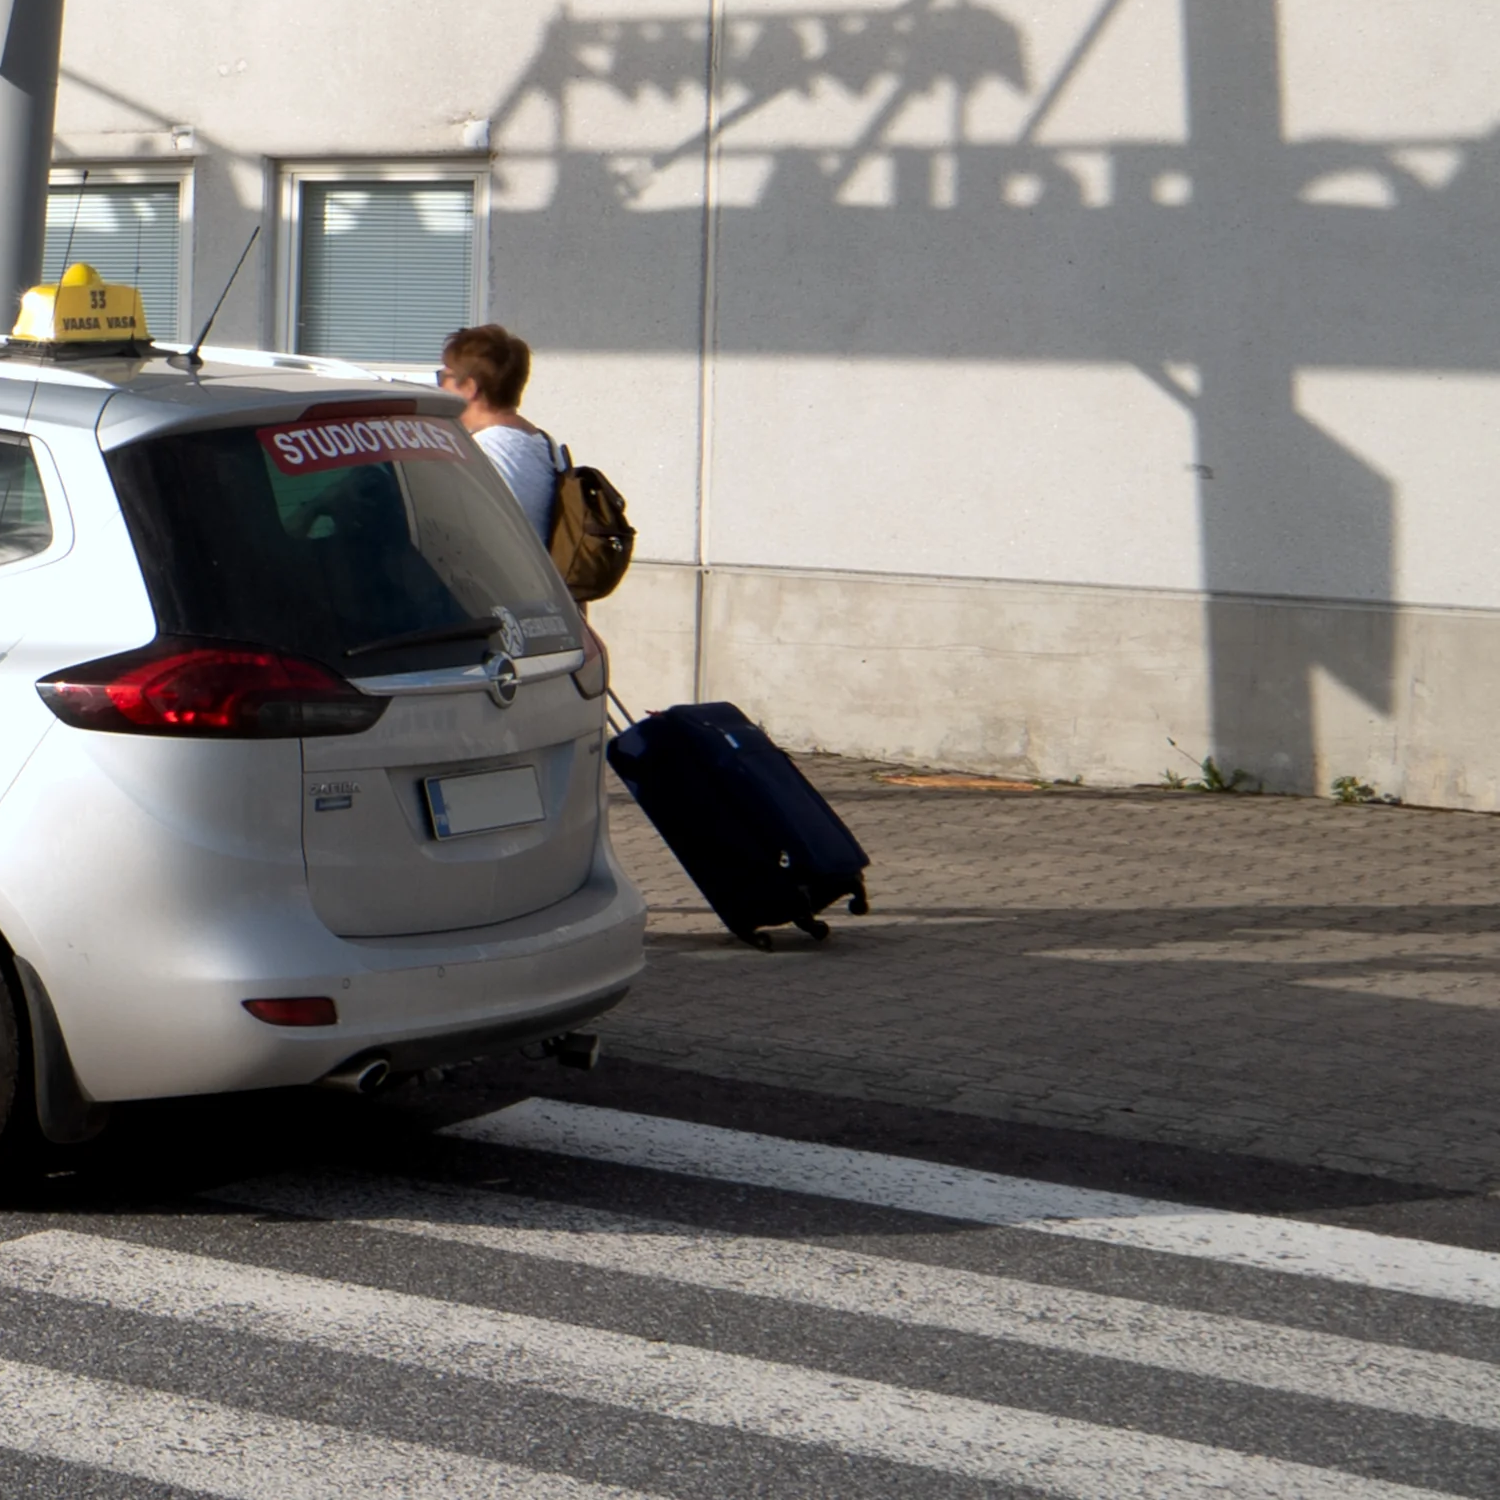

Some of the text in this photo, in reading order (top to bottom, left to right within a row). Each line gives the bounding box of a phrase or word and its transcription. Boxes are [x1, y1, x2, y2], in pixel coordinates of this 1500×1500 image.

[89, 290, 106, 309] 33
[62, 316, 136, 330] VAASA VASA
[273, 419, 467, 465] STUDIOTICKET
